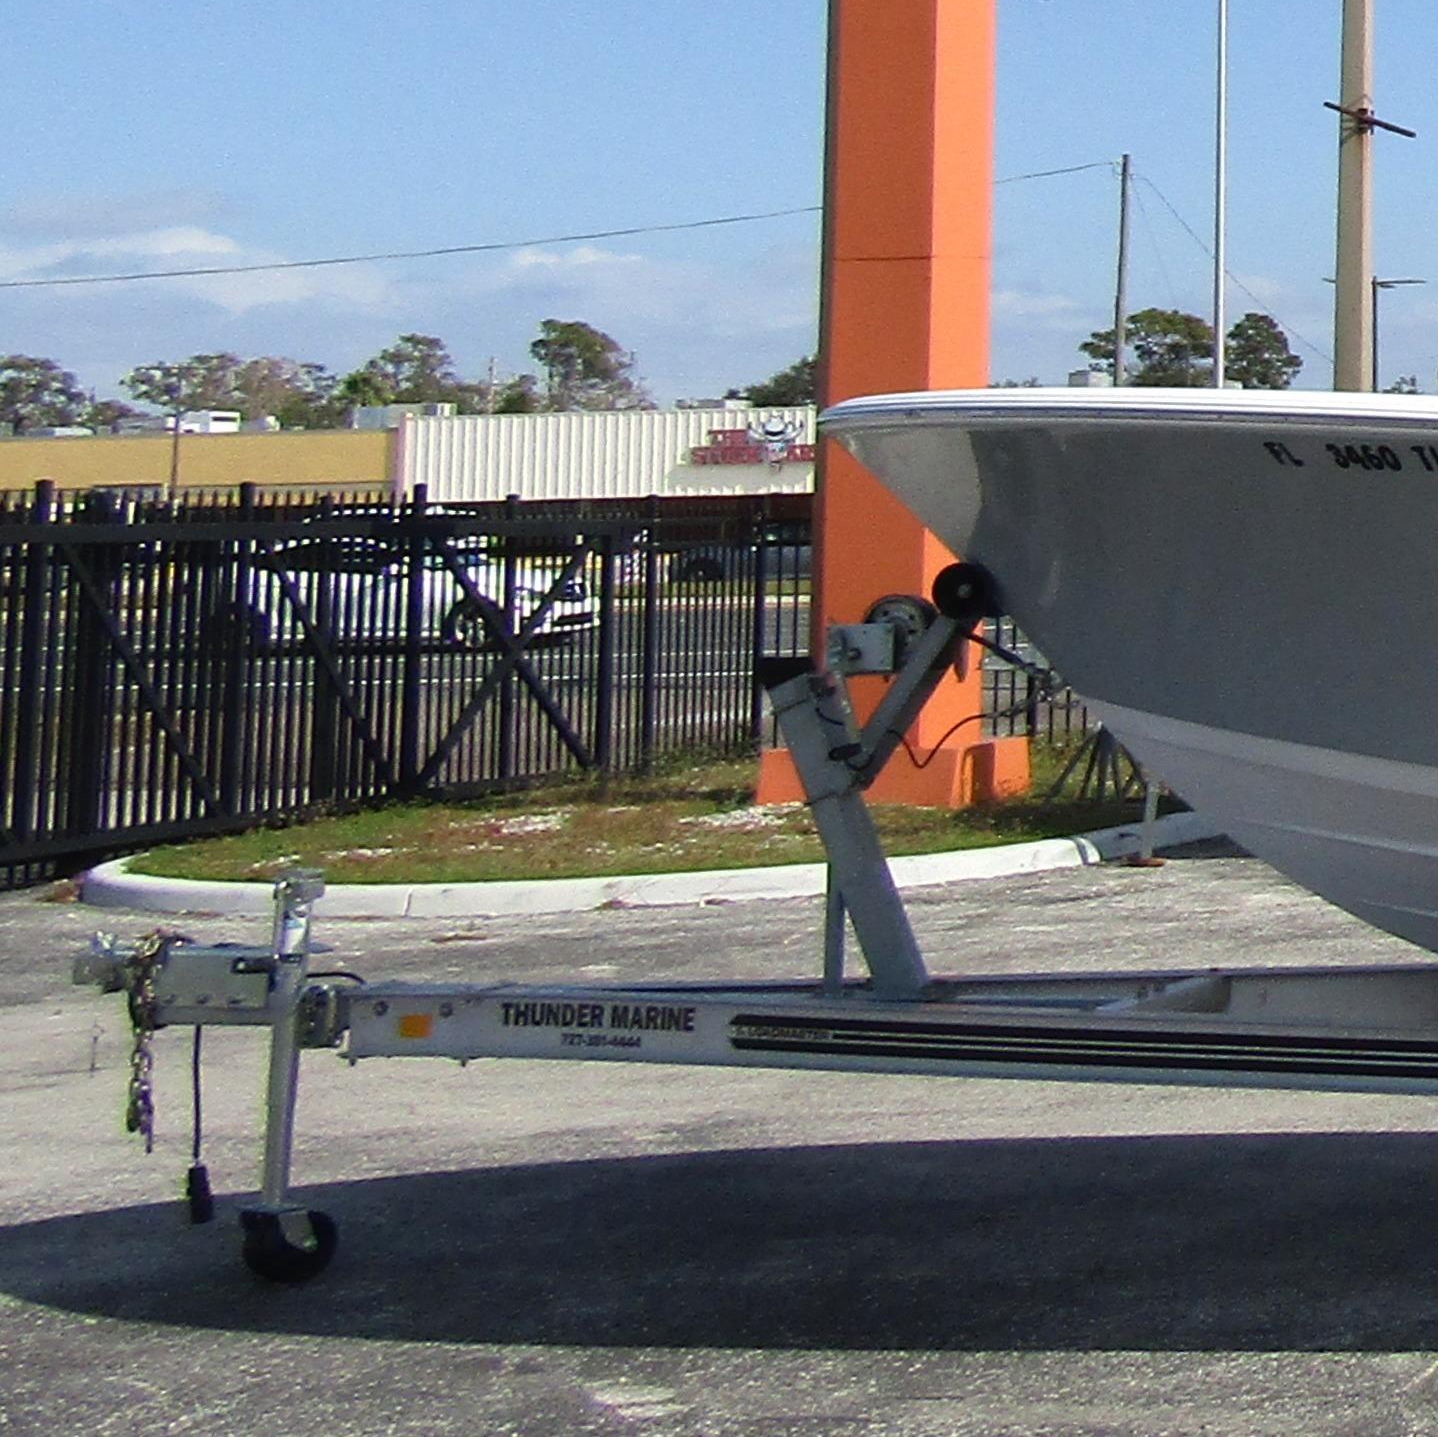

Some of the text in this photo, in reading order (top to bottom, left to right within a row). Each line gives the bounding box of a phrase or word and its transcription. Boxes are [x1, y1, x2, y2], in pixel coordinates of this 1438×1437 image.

[1263, 441, 1304, 467] FL
[1325, 443, 1402, 471] 3460
[502, 1002, 695, 1031] THUNDER MARINE
